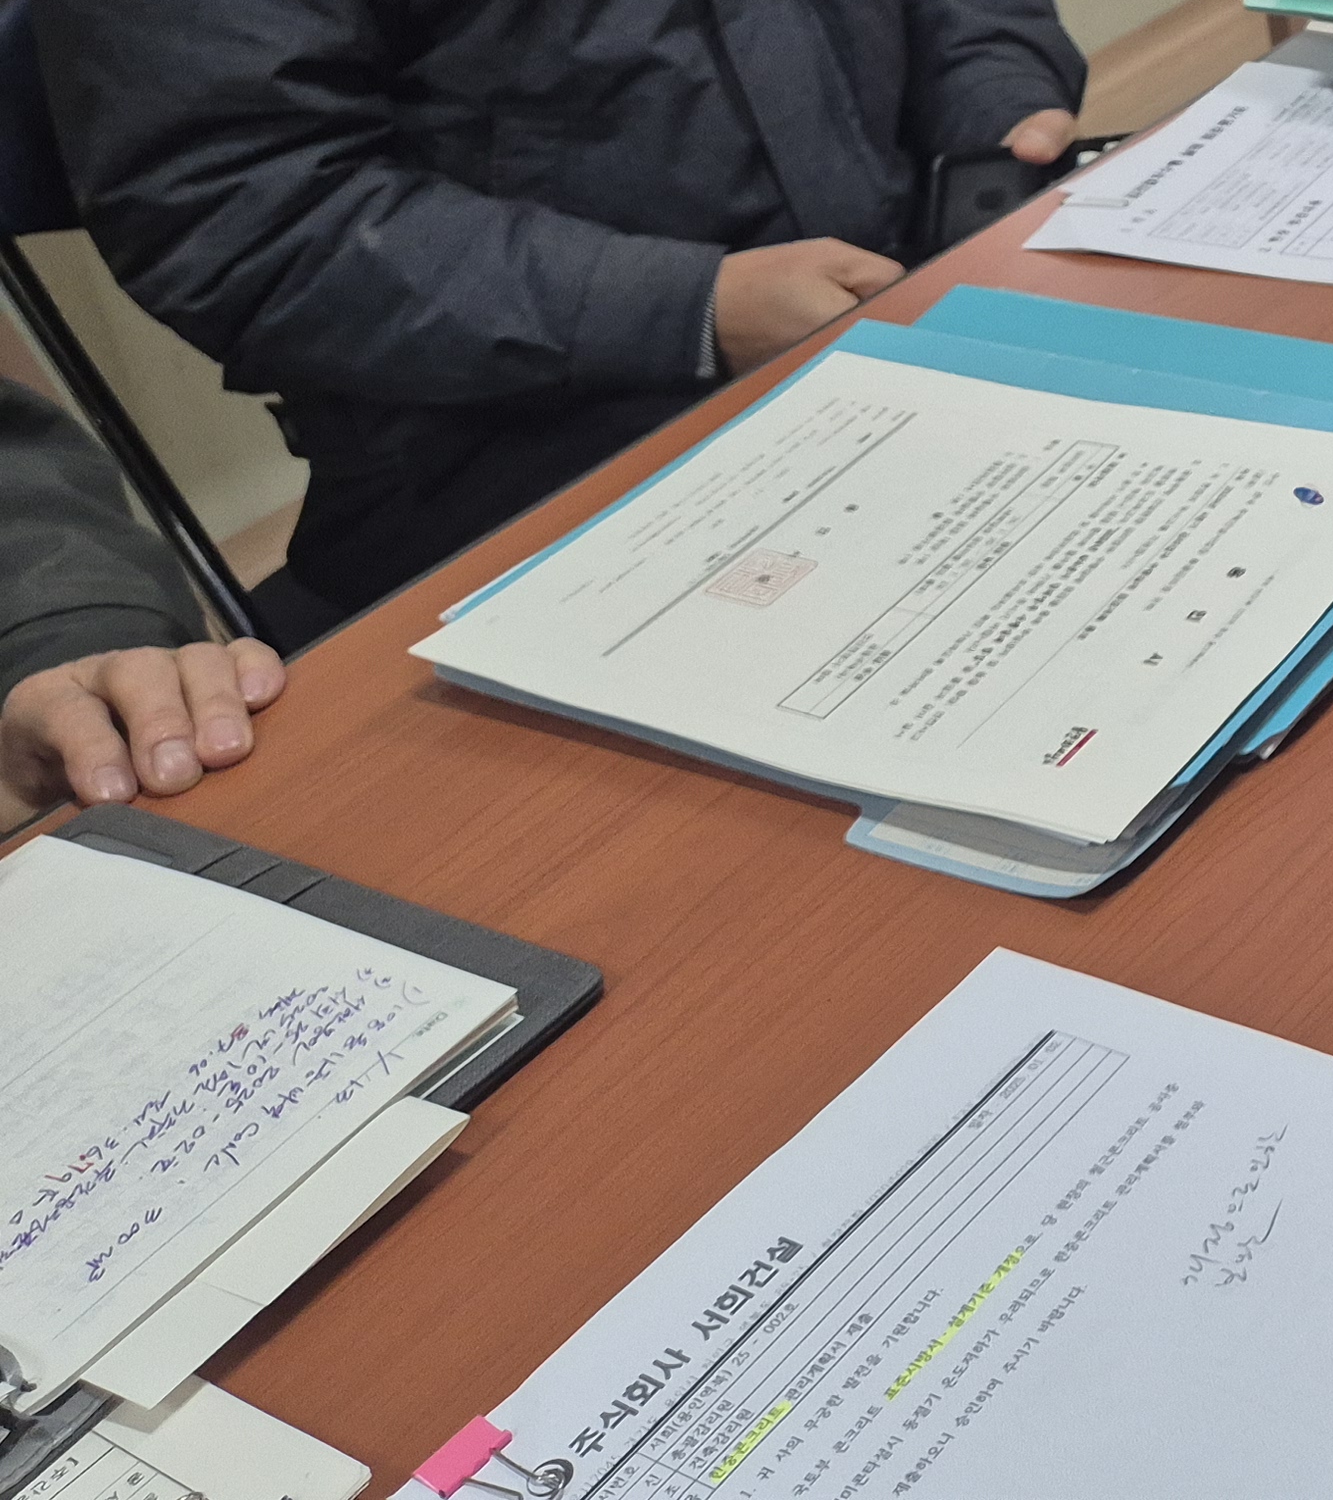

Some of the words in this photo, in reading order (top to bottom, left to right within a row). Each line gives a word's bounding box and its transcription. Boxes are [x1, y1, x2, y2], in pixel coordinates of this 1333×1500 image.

[1141, 651, 1163, 667] 시
[1184, 609, 1207, 623] 인
[570, 1348, 691, 1458] 주식회사
[693, 1236, 803, 1340] 서희건설
[650, 1368, 733, 1451] 서희(용인역북)
[728, 1347, 751, 1367] 25
[760, 1298, 801, 1334] 002호
[739, 1487, 757, 1500] 1.
[755, 1465, 776, 1481] 귀
[775, 1435, 805, 1463] 사의
[803, 1393, 845, 1432] 무궁한
[841, 1353, 884, 1389] 발전을
[881, 1287, 944, 1348] 기원합니다.
[789, 1458, 832, 1498] 국토부
[832, 1404, 884, 1454] 콘크리트
[883, 1335, 944, 1400] 표준시방서
[947, 1281, 1000, 1328] 설계기준
[1040, 1213, 1059, 1227] 당
[1055, 1178, 1092, 1211] 현장의
[833, 1435, 904, 1500] 미콘타설시
[902, 1392, 943, 1431] 동절기
[941, 1328, 1001, 1389] 온도저하가
[998, 1267, 1056, 1324] 우려되므로
[1053, 1199, 1118, 1263] 한중콘크리트
[1115, 1134, 1176, 1196] 관리계획서를
[891, 1431, 956, 1496] 제출하오니
[955, 1377, 1004, 1427] 승인하여
[1002, 1336, 1041, 1374] 주시기
[1037, 1284, 1088, 1333] 바랍니다.
[671, 1398, 735, 1463] 총괄감리원
[688, 1407, 756, 1472] 건축감리원
[708, 1406, 785, 1479] 한중콘크리트
[784, 1340, 847, 1403] 관리계획서
[845, 1312, 875, 1337] 제출
[644, 1472, 663, 1488] 신
[663, 1483, 682, 1499] 조
